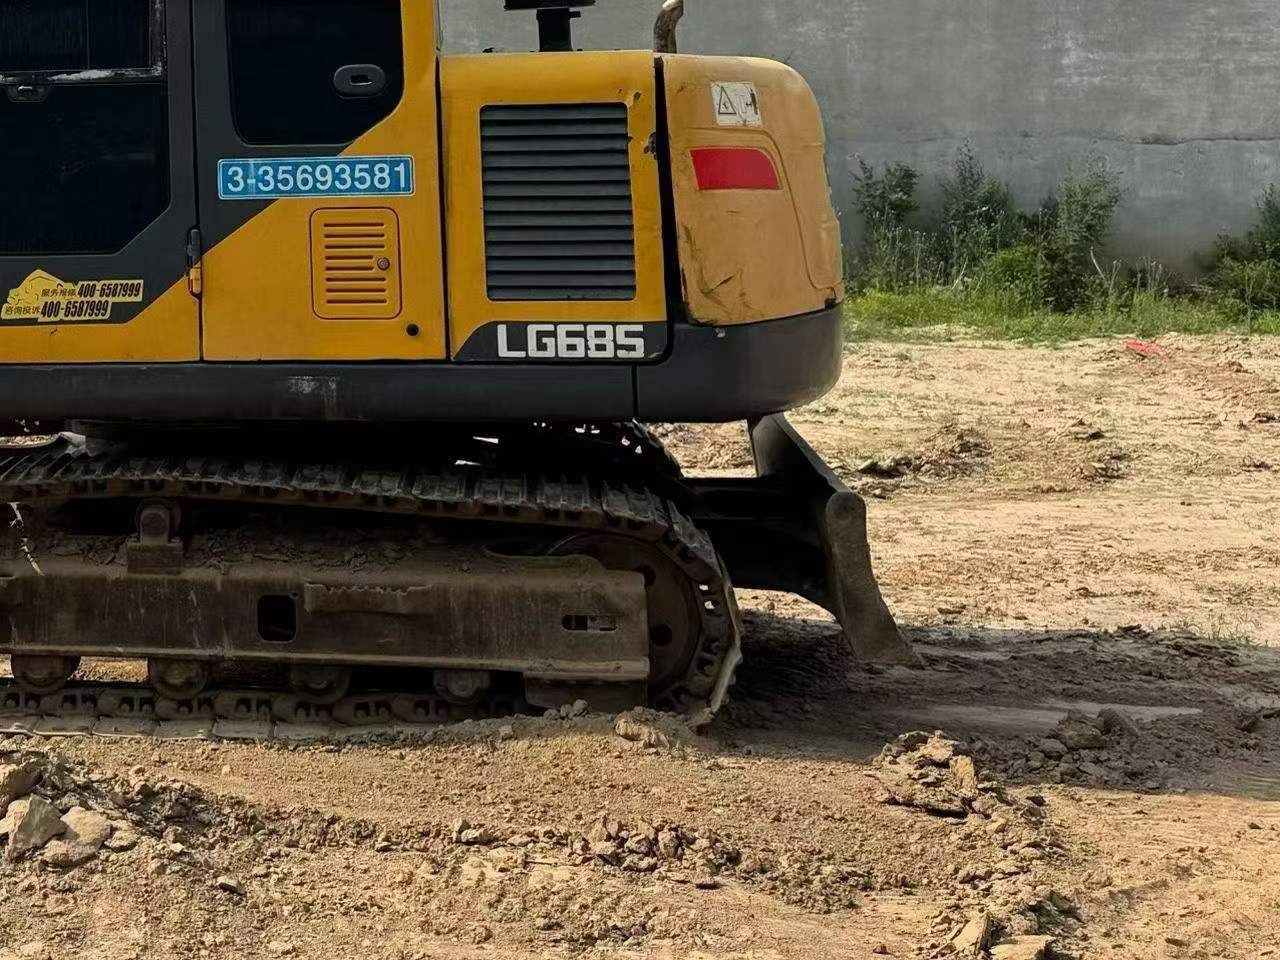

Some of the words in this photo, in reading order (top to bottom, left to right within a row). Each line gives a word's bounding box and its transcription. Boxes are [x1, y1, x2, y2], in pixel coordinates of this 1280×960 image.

[227, 163, 406, 192] 3-35693581
[78, 282, 141, 298] 400-6587999
[41, 300, 109, 318] 400-6587999
[497, 324, 645, 359] LG685
